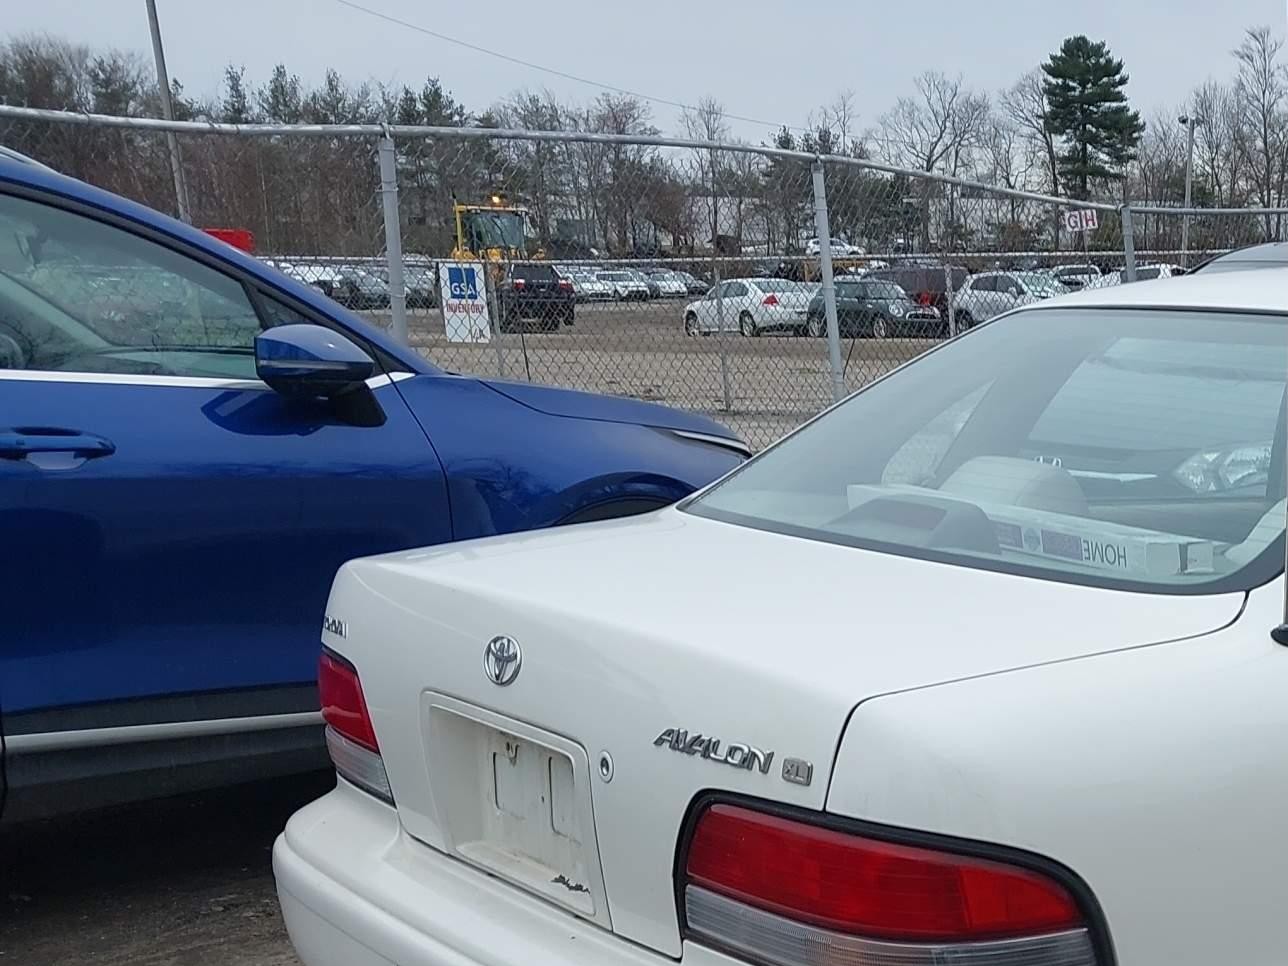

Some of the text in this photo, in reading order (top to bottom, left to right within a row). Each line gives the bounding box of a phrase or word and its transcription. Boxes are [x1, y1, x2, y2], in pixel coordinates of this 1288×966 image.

[451, 282, 476, 295] GSA
[447, 303, 485, 314] INVENTORY
[1083, 539, 1128, 568] HOME
[653, 727, 775, 775] AVALON
